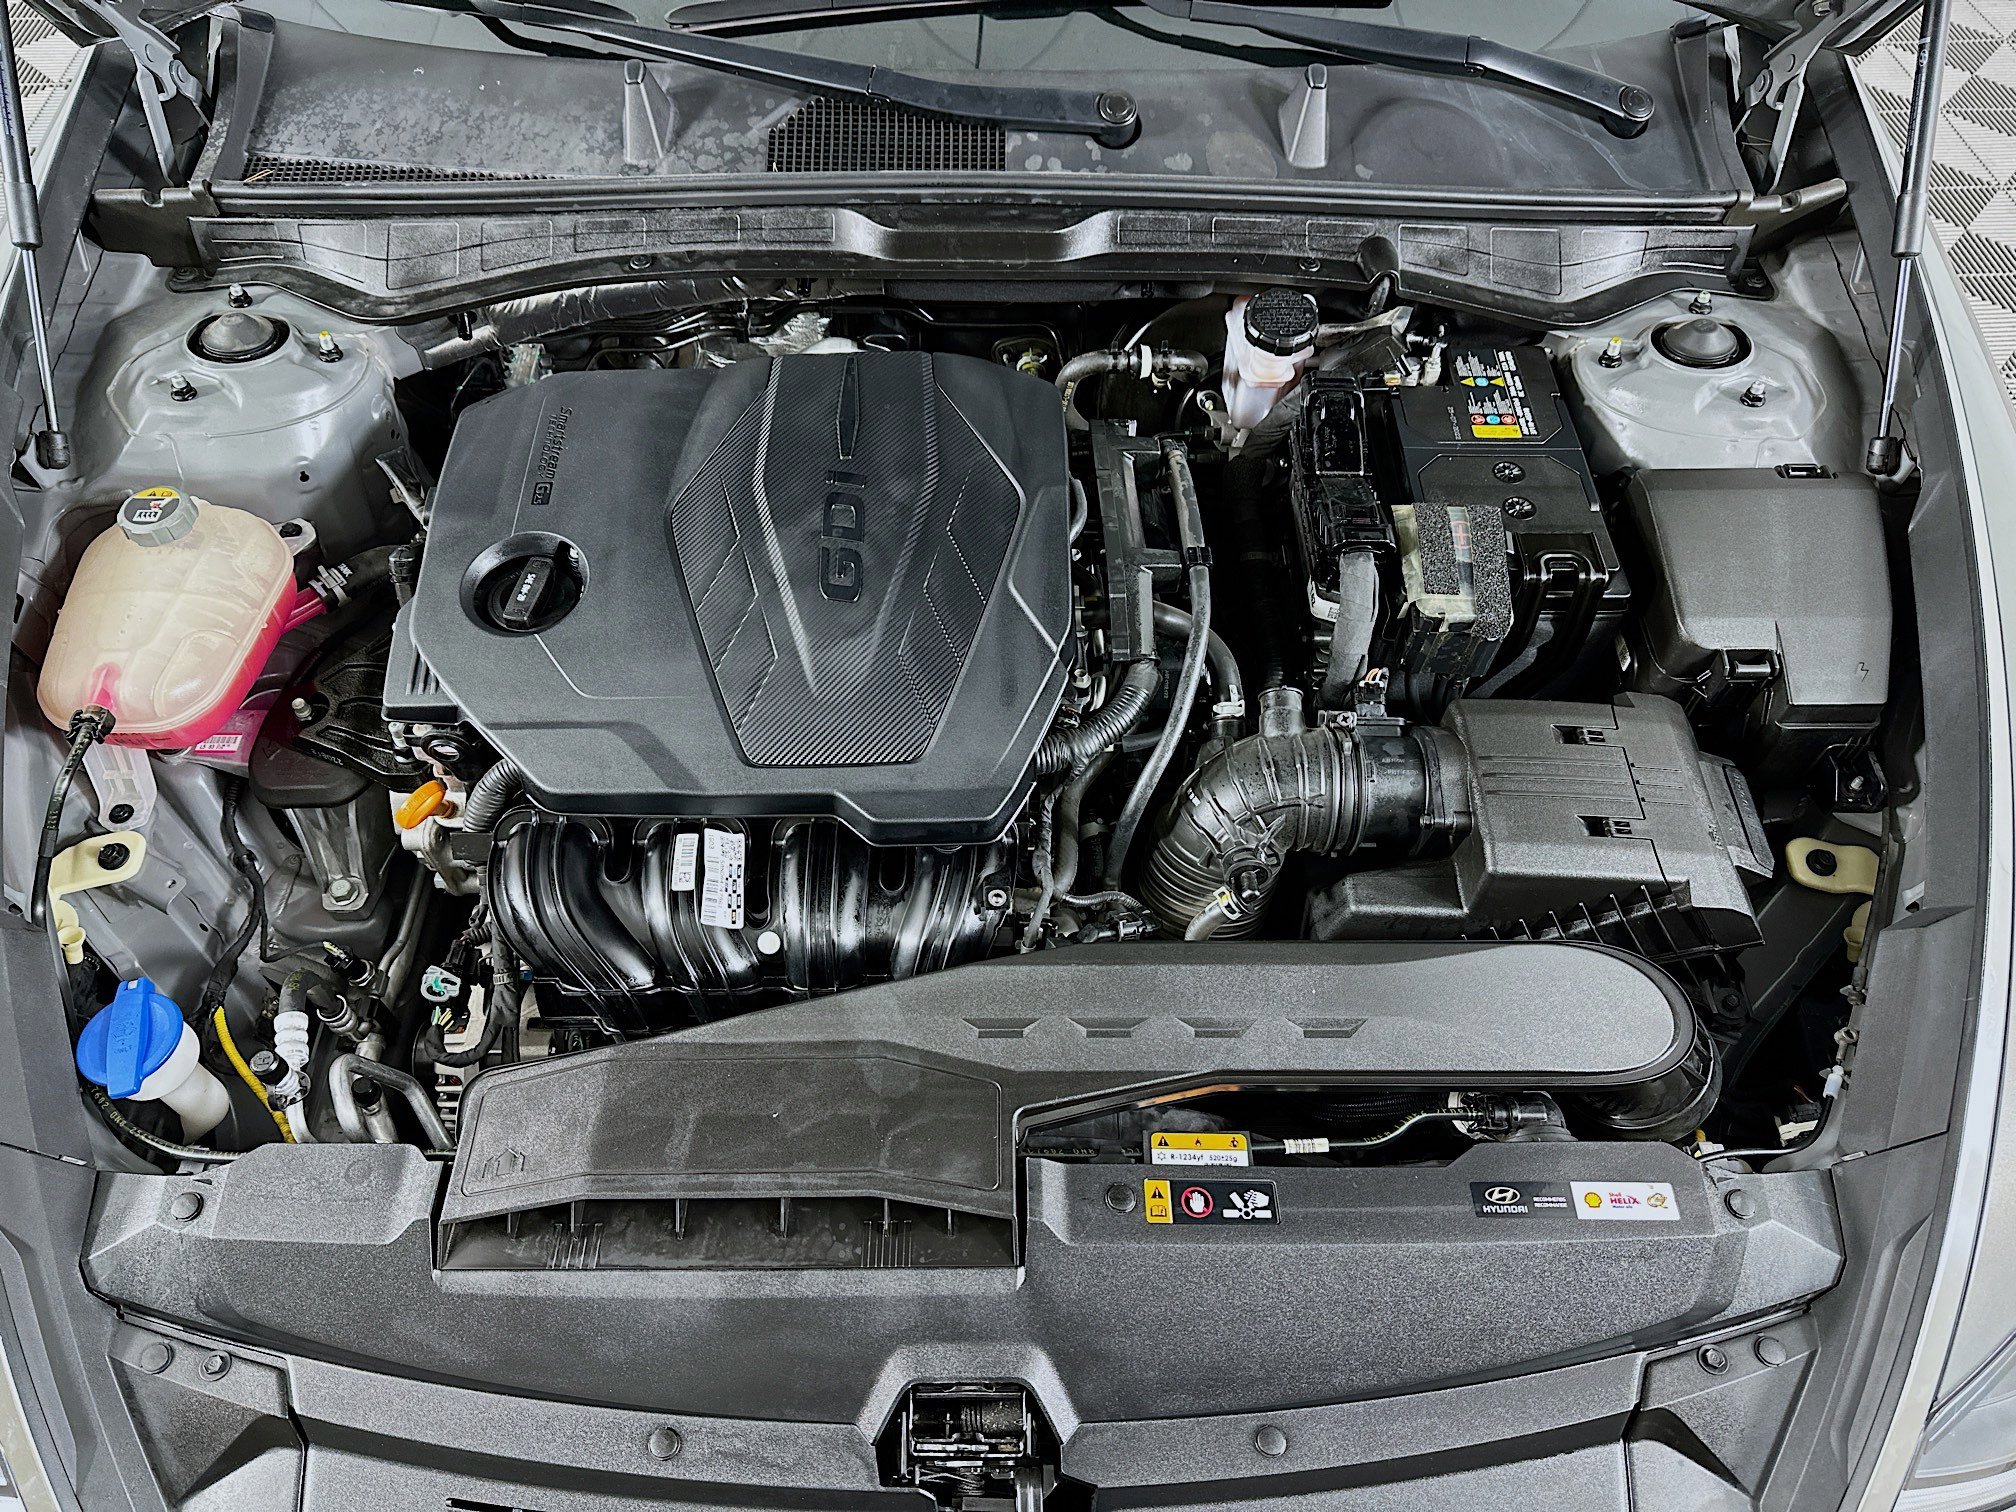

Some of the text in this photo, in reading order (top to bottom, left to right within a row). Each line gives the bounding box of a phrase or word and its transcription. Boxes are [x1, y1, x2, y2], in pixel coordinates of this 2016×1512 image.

[538, 414, 557, 479] TECHNOLOGY
[546, 406, 572, 479] Smartstream
[819, 469, 866, 604] GDI
[1170, 1153, 1238, 1163] R-1234yf 520±25g
[1482, 1205, 1529, 1214] HYUNDAI
[1610, 1195, 1641, 1205] HELIX
